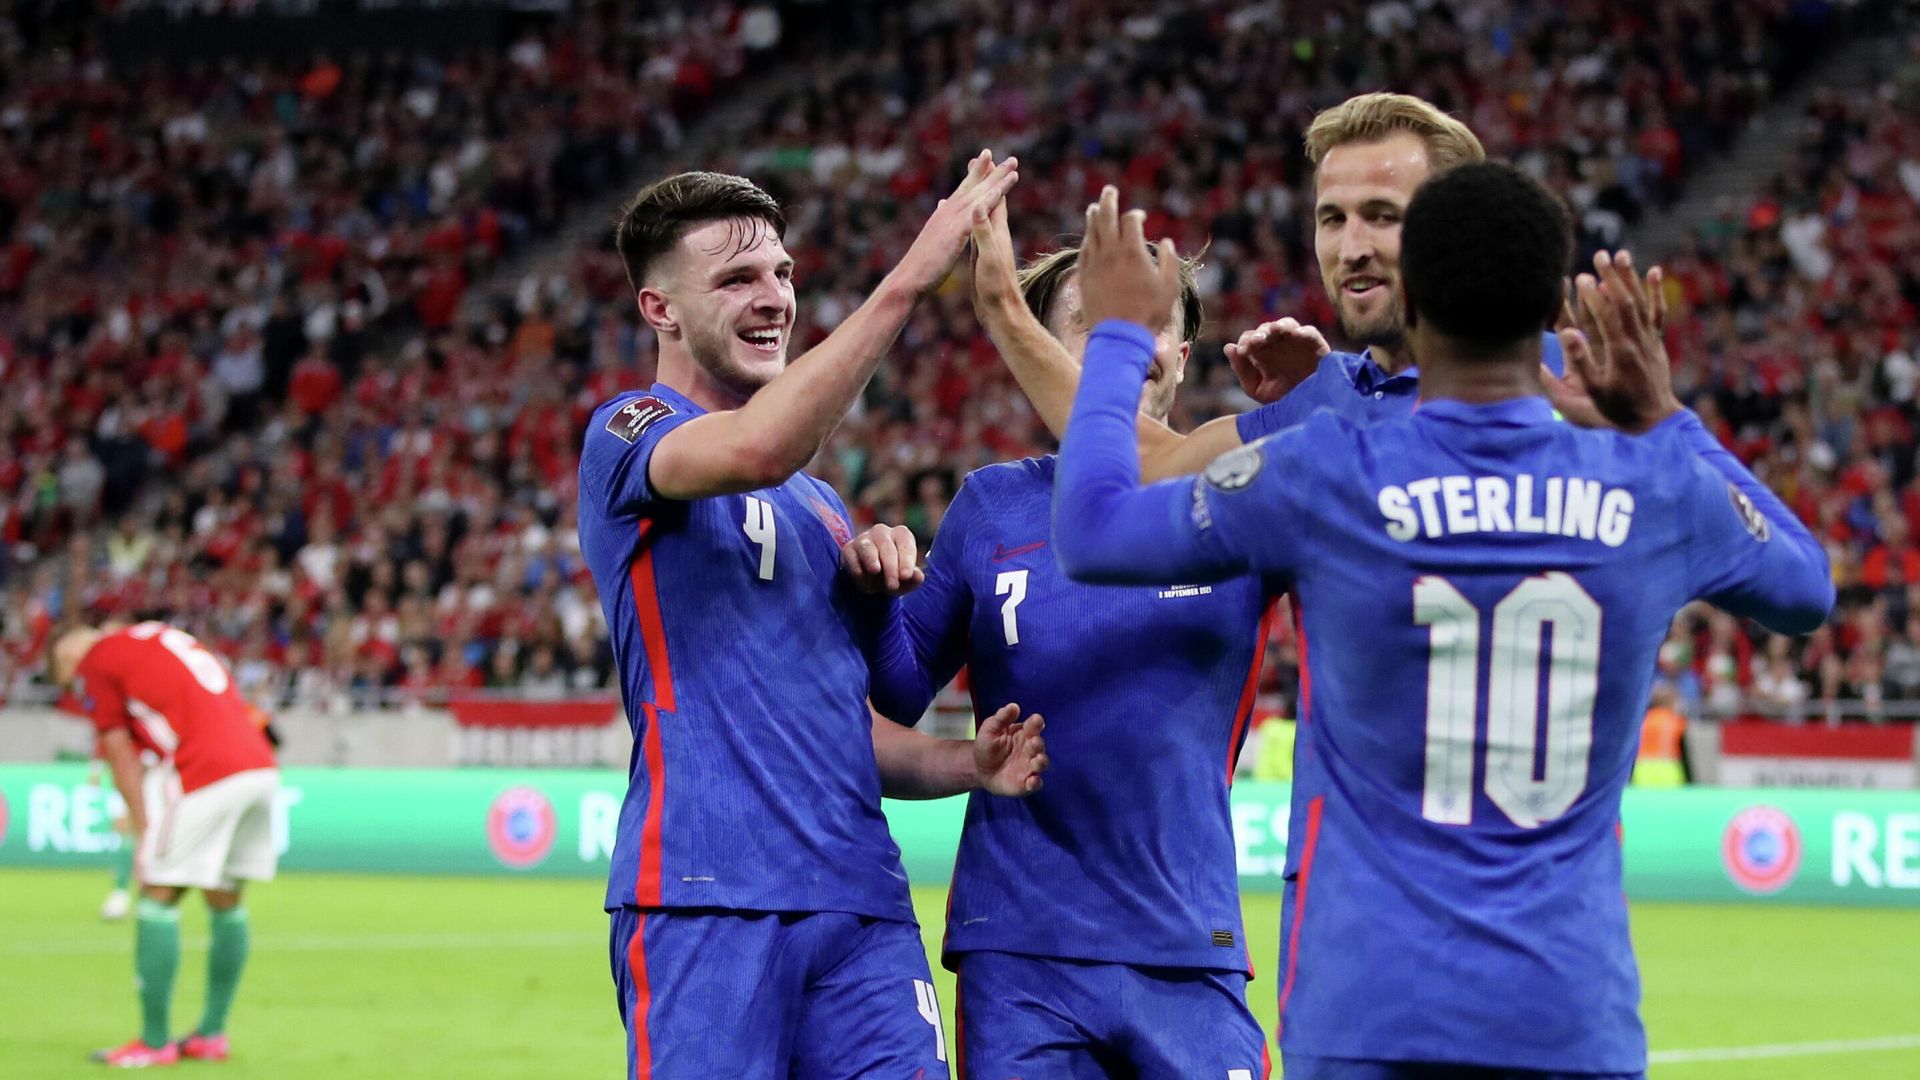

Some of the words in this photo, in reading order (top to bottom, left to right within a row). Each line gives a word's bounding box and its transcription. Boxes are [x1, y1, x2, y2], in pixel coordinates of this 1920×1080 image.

[743, 496, 776, 581] 4
[1377, 473, 1635, 548] STERLING
[995, 569, 1029, 647] 7
[1164, 588, 1199, 598] SEPTEMBER
[1412, 570, 1603, 830] 10
[913, 979, 947, 1062] 4
